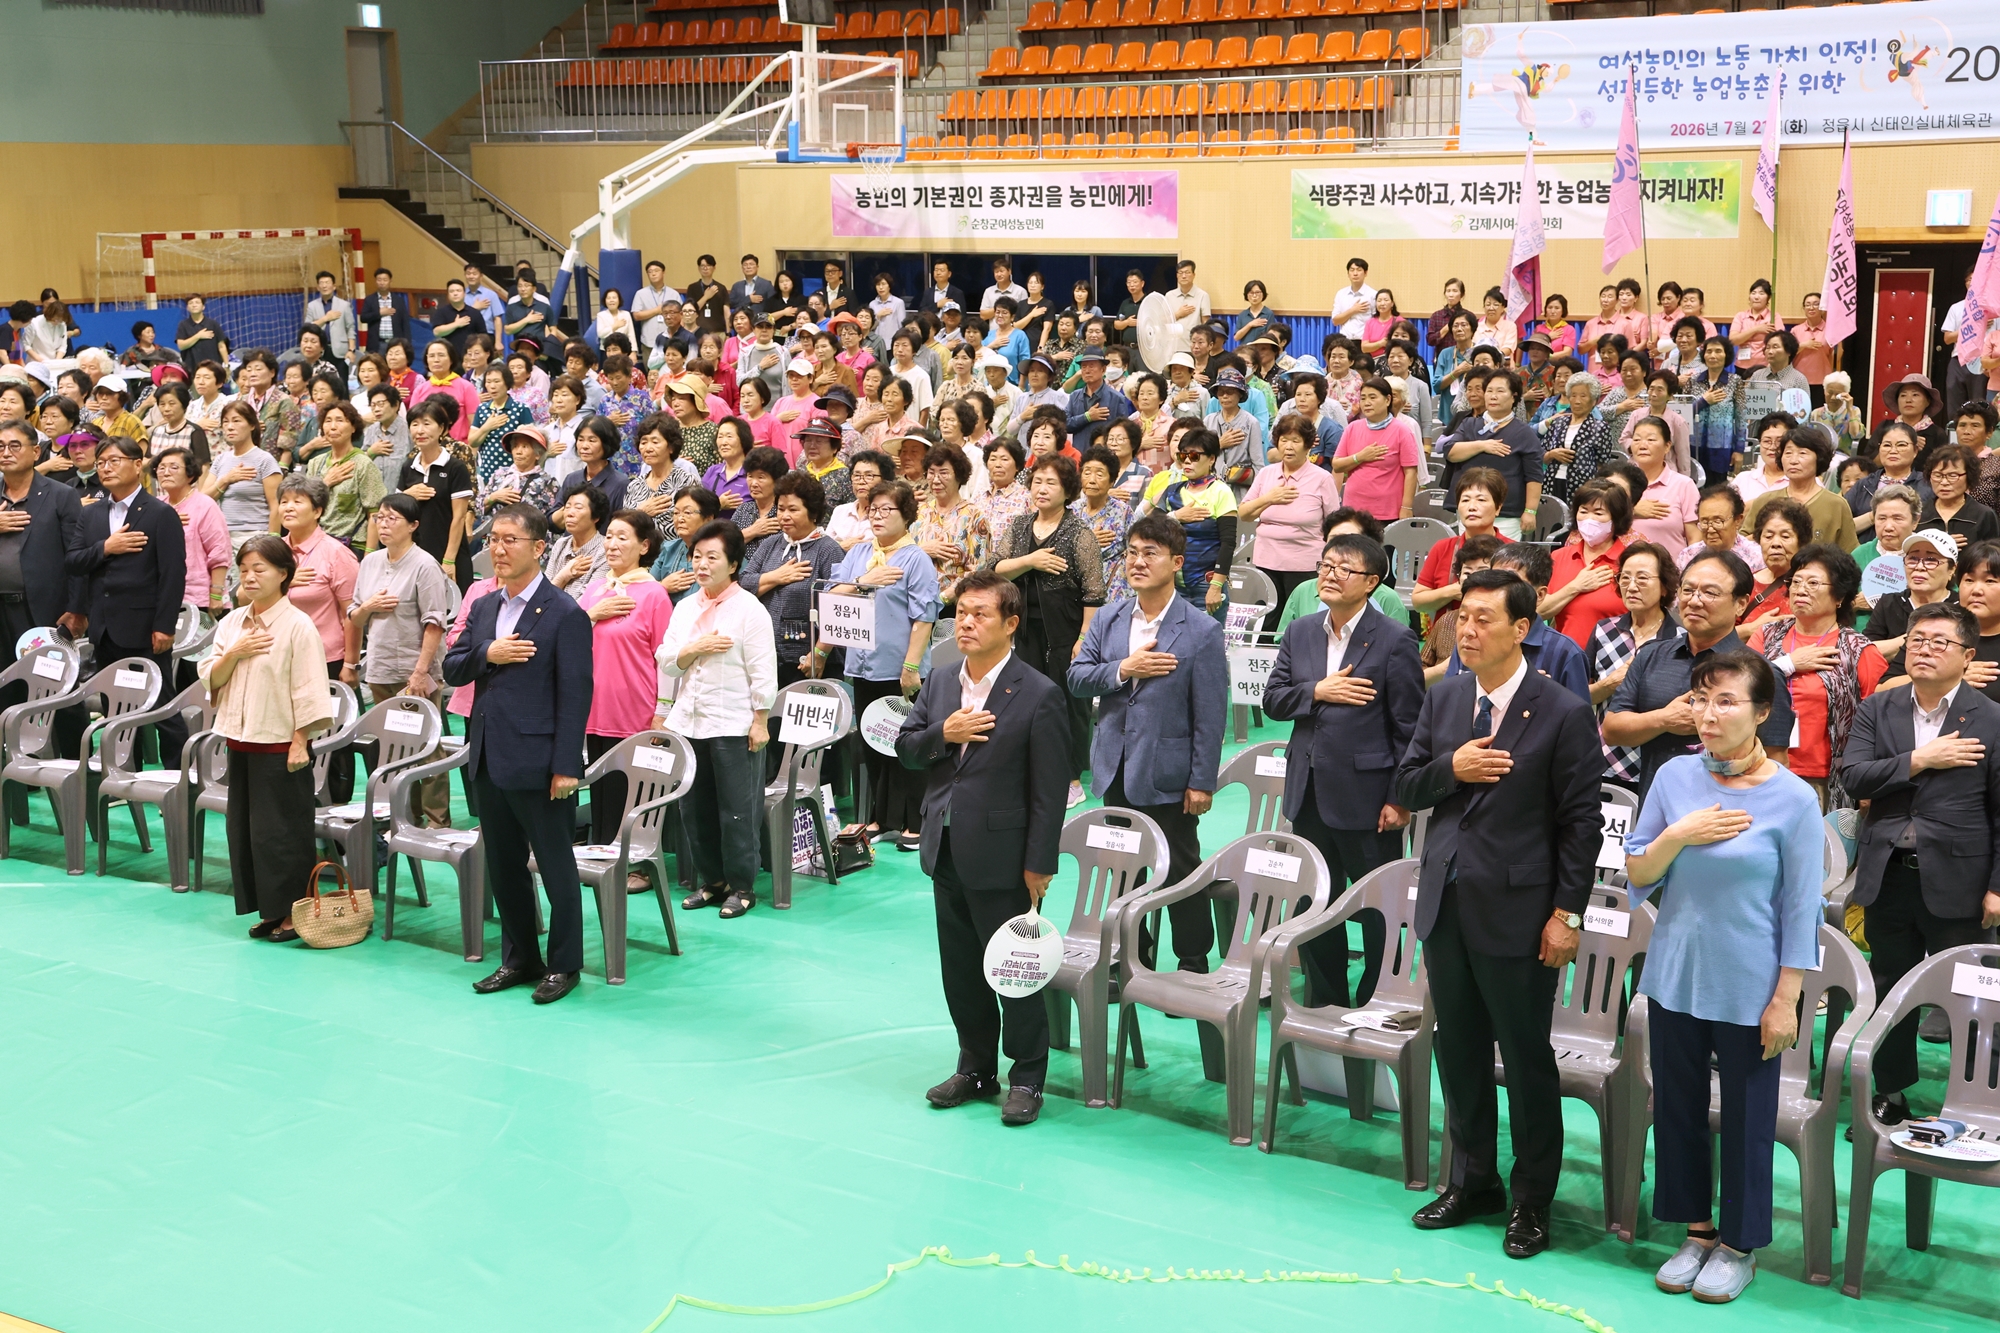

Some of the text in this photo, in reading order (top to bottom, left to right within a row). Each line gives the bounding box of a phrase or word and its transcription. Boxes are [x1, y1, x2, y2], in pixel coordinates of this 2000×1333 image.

[1598, 38, 1877, 74] 여성농민의 노동 가치 인정!
[1798, 71, 1846, 95] 위한
[1670, 121, 1718, 136] 2026년
[1724, 120, 1746, 136] 7월
[1822, 117, 1865, 134] 정읍시
[1870, 113, 1993, 131] 신태인실내체육관
[913, 186, 983, 208] 기본권인
[989, 185, 1063, 208] 종자권을
[1069, 183, 1152, 208] 농민에게!
[1308, 183, 1375, 208] 식량주권
[1379, 181, 1455, 207] 사수하고,
[1638, 177, 1724, 203] 지켜내자!
[970, 218, 1044, 232] 순창군여성농민회
[833, 603, 861, 619] 정읍시
[824, 624, 870, 642] 여성농민회
[1238, 681, 1266, 697] 여성
[787, 702, 834, 730] 내빈석
[1105, 840, 1126, 850] 정읍시장
